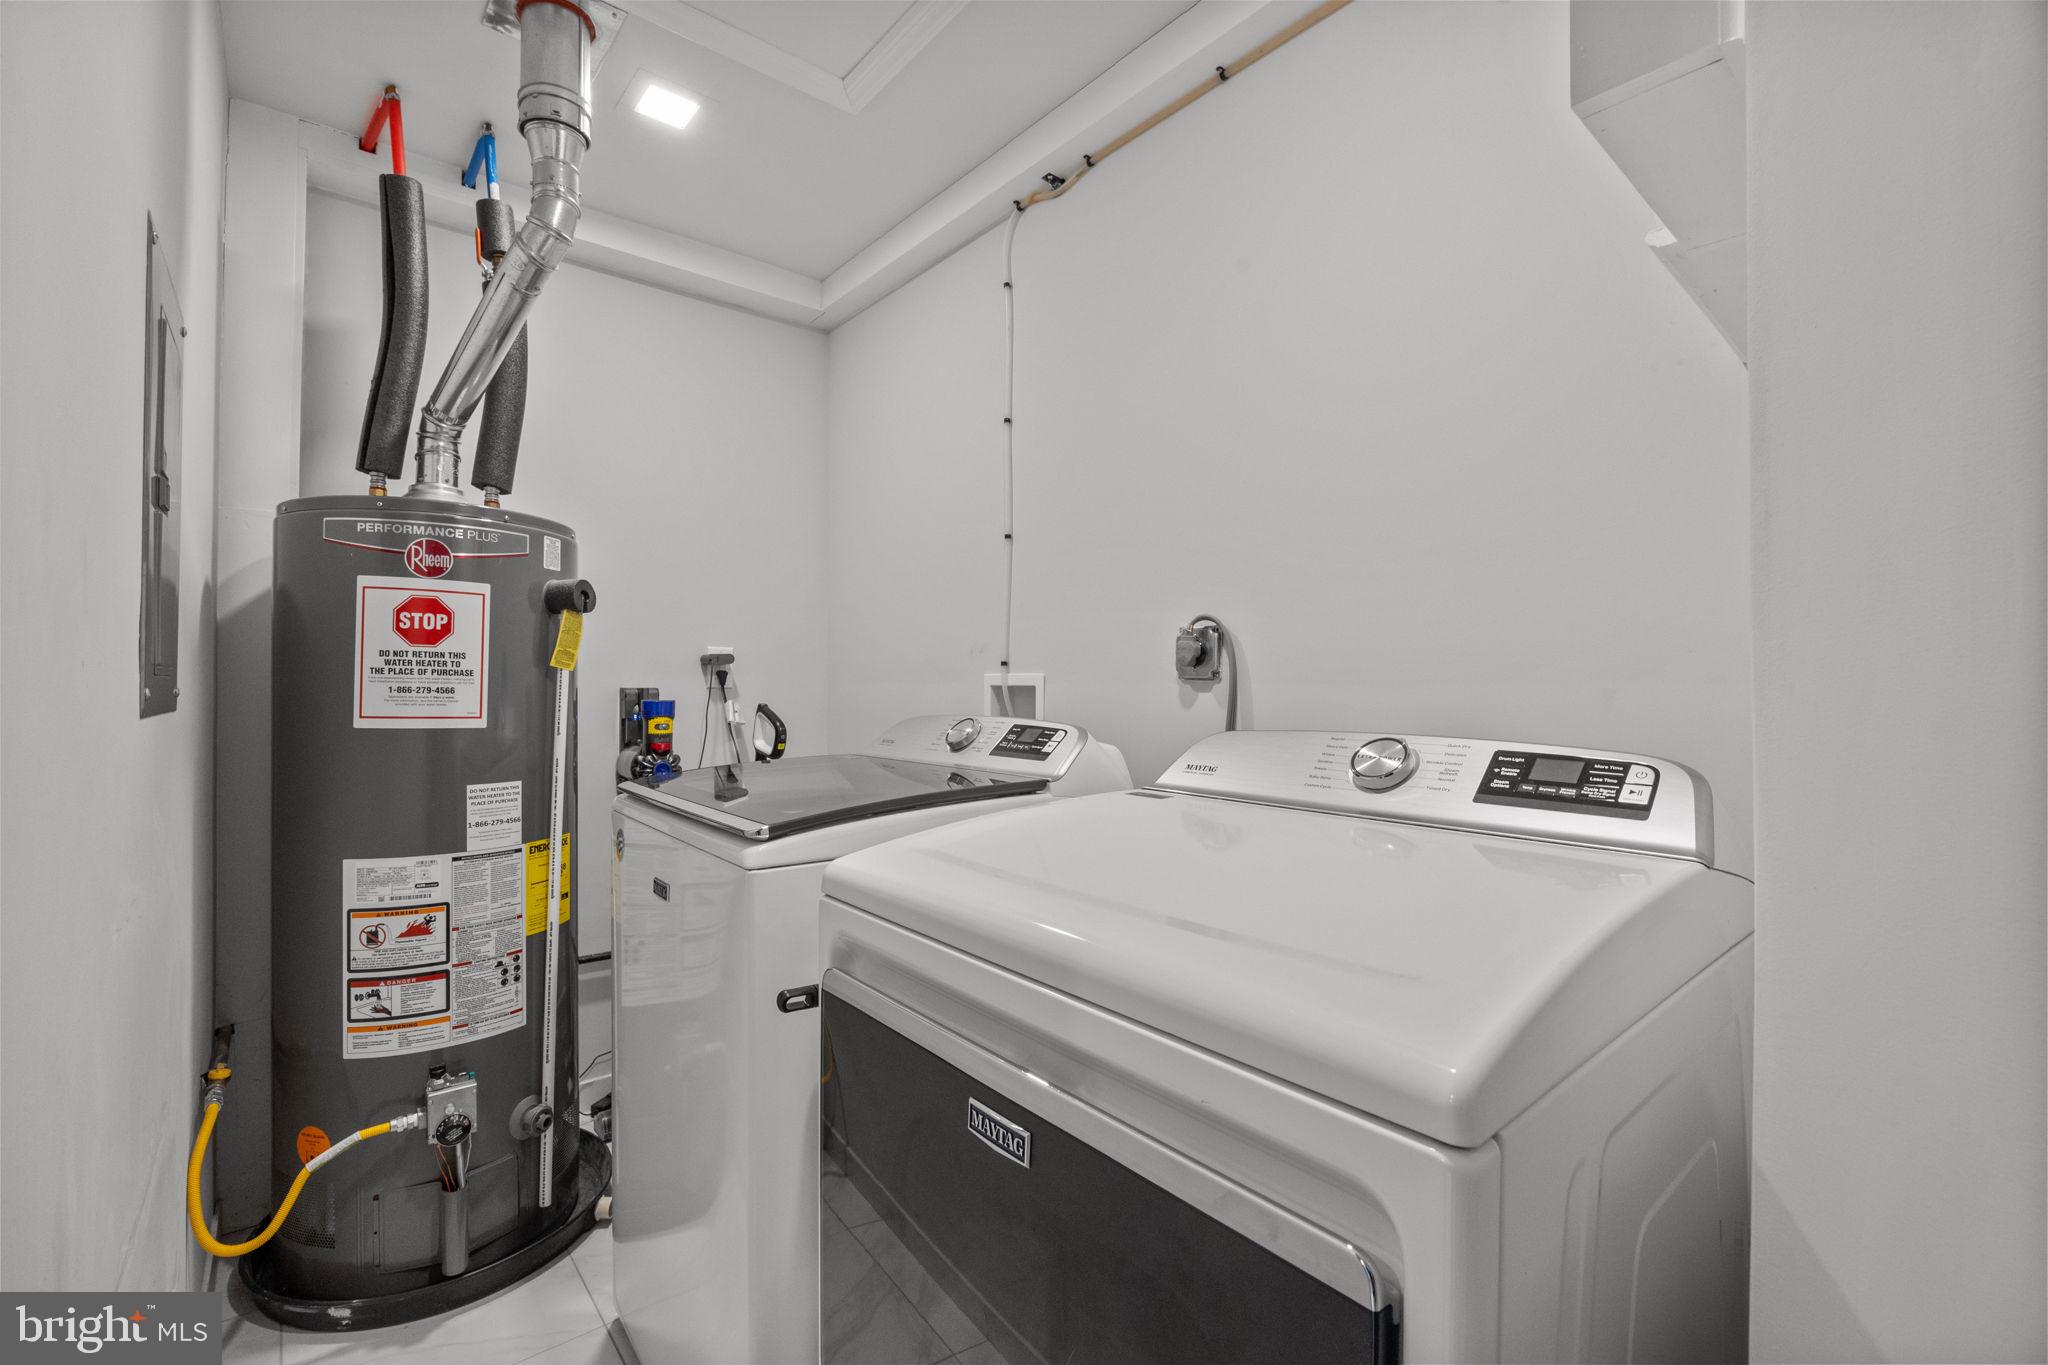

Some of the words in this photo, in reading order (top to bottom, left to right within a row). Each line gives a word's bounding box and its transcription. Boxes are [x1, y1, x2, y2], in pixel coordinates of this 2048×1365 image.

[357, 522, 464, 539] PERFORMANCE
[467, 532, 502, 545] PLUS
[410, 540, 451, 572] Rheem
[399, 611, 448, 630] STOP
[412, 651, 445, 659] RETURN
[448, 652, 466, 660] THIS
[384, 659, 413, 667] WATER
[416, 660, 447, 668] HEATER
[451, 661, 461, 669] TO
[370, 667, 385, 675] THE
[388, 668, 415, 676] PLACE
[431, 669, 475, 677] PURCHASE
[388, 686, 456, 695] 1-866-279-4566
[1184, 764, 1218, 772] MAYTAG
[468, 816, 521, 829] 1-866-279-4566
[386, 977, 417, 986] DANGER
[386, 1022, 419, 1030] WARNING
[971, 1109, 1024, 1157] MAYTAG
